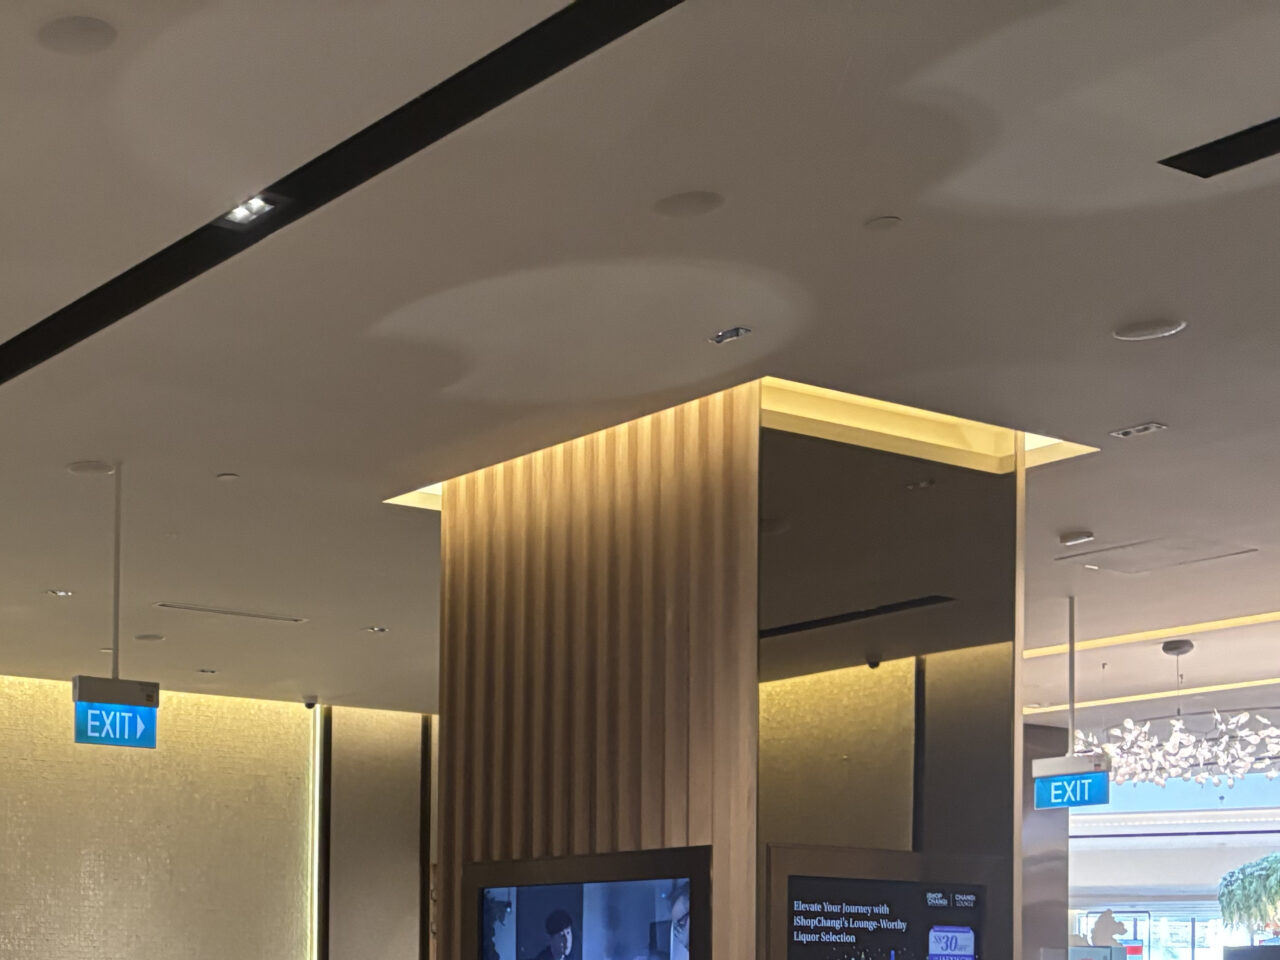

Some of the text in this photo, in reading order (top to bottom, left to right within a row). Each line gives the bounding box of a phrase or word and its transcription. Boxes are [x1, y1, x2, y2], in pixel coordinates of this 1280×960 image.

[87, 709, 133, 740] EXIT
[1050, 779, 1093, 803] EXIT
[793, 900, 890, 916] Elevate Your Journey with
[793, 916, 908, 932] iShopChangi's Lounge-Worthy
[793, 931, 856, 944] Liquor Selection
